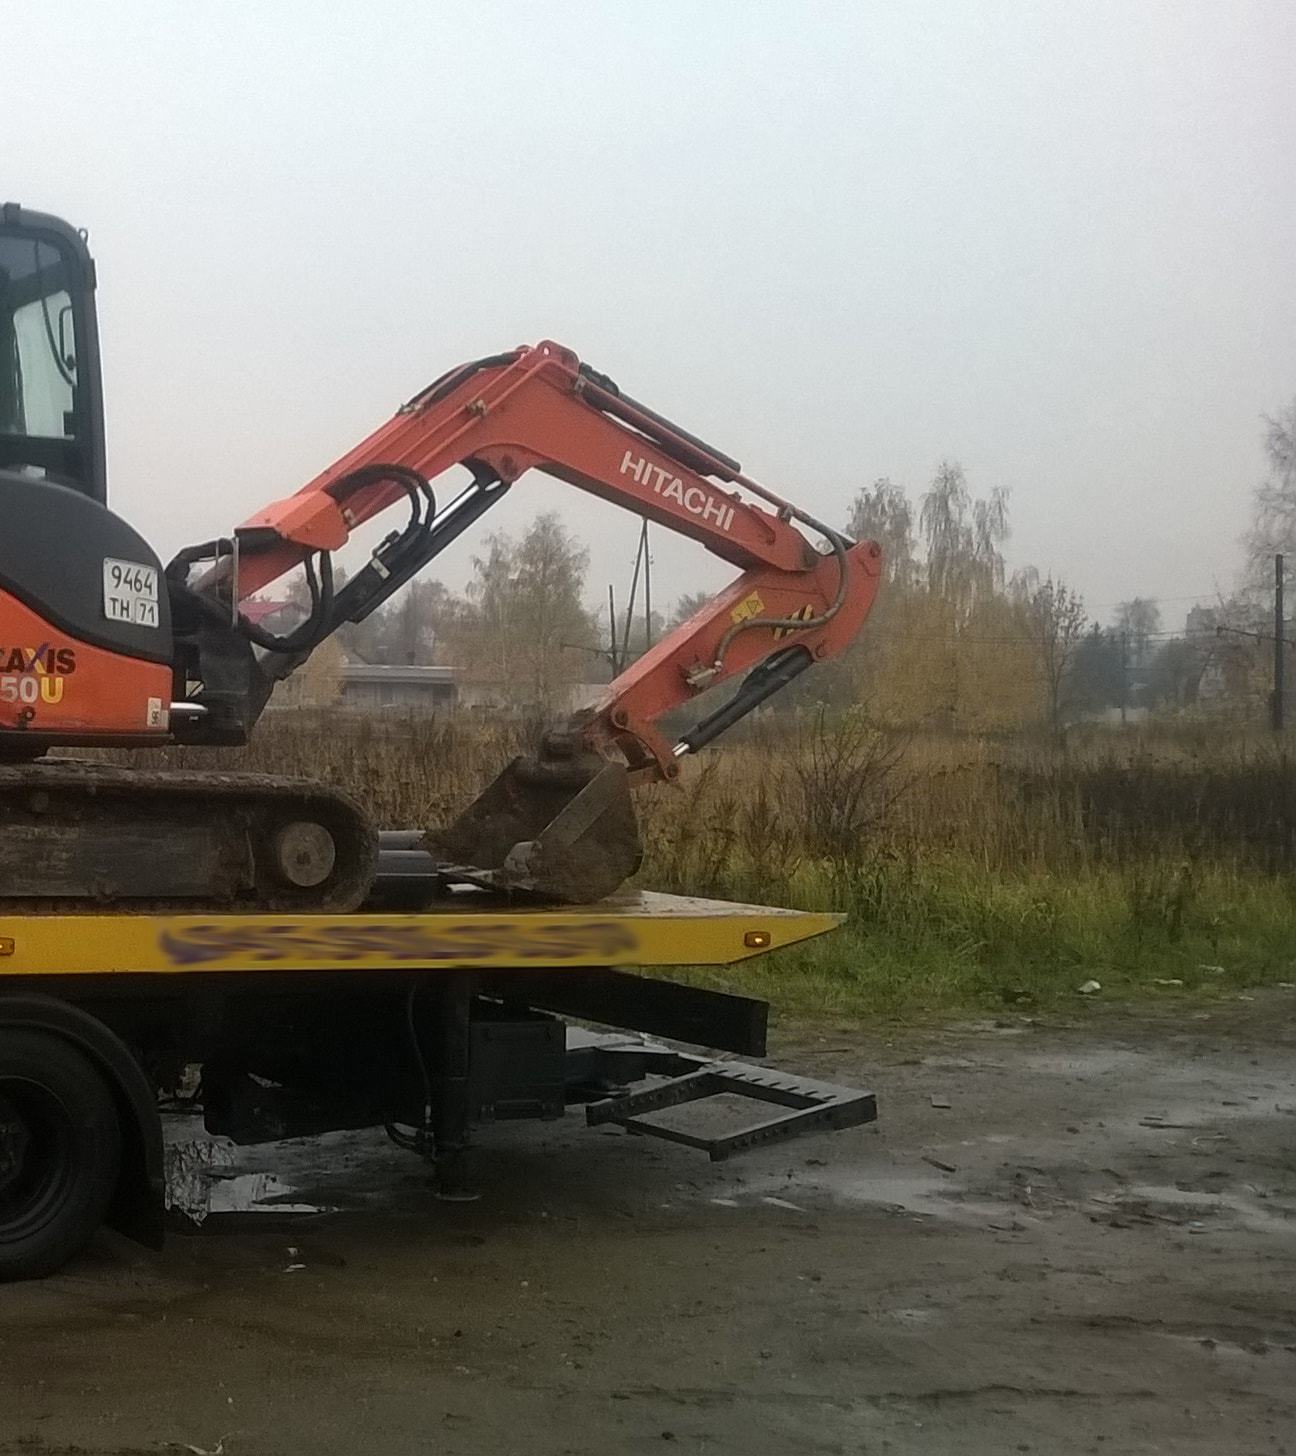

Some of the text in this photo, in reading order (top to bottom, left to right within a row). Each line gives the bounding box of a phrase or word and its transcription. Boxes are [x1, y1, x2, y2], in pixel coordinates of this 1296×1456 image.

[619, 450, 736, 532] HITACHI
[111, 565, 153, 596] 9464
[109, 597, 155, 625] TH 71
[0, 676, 65, 704] 50U
